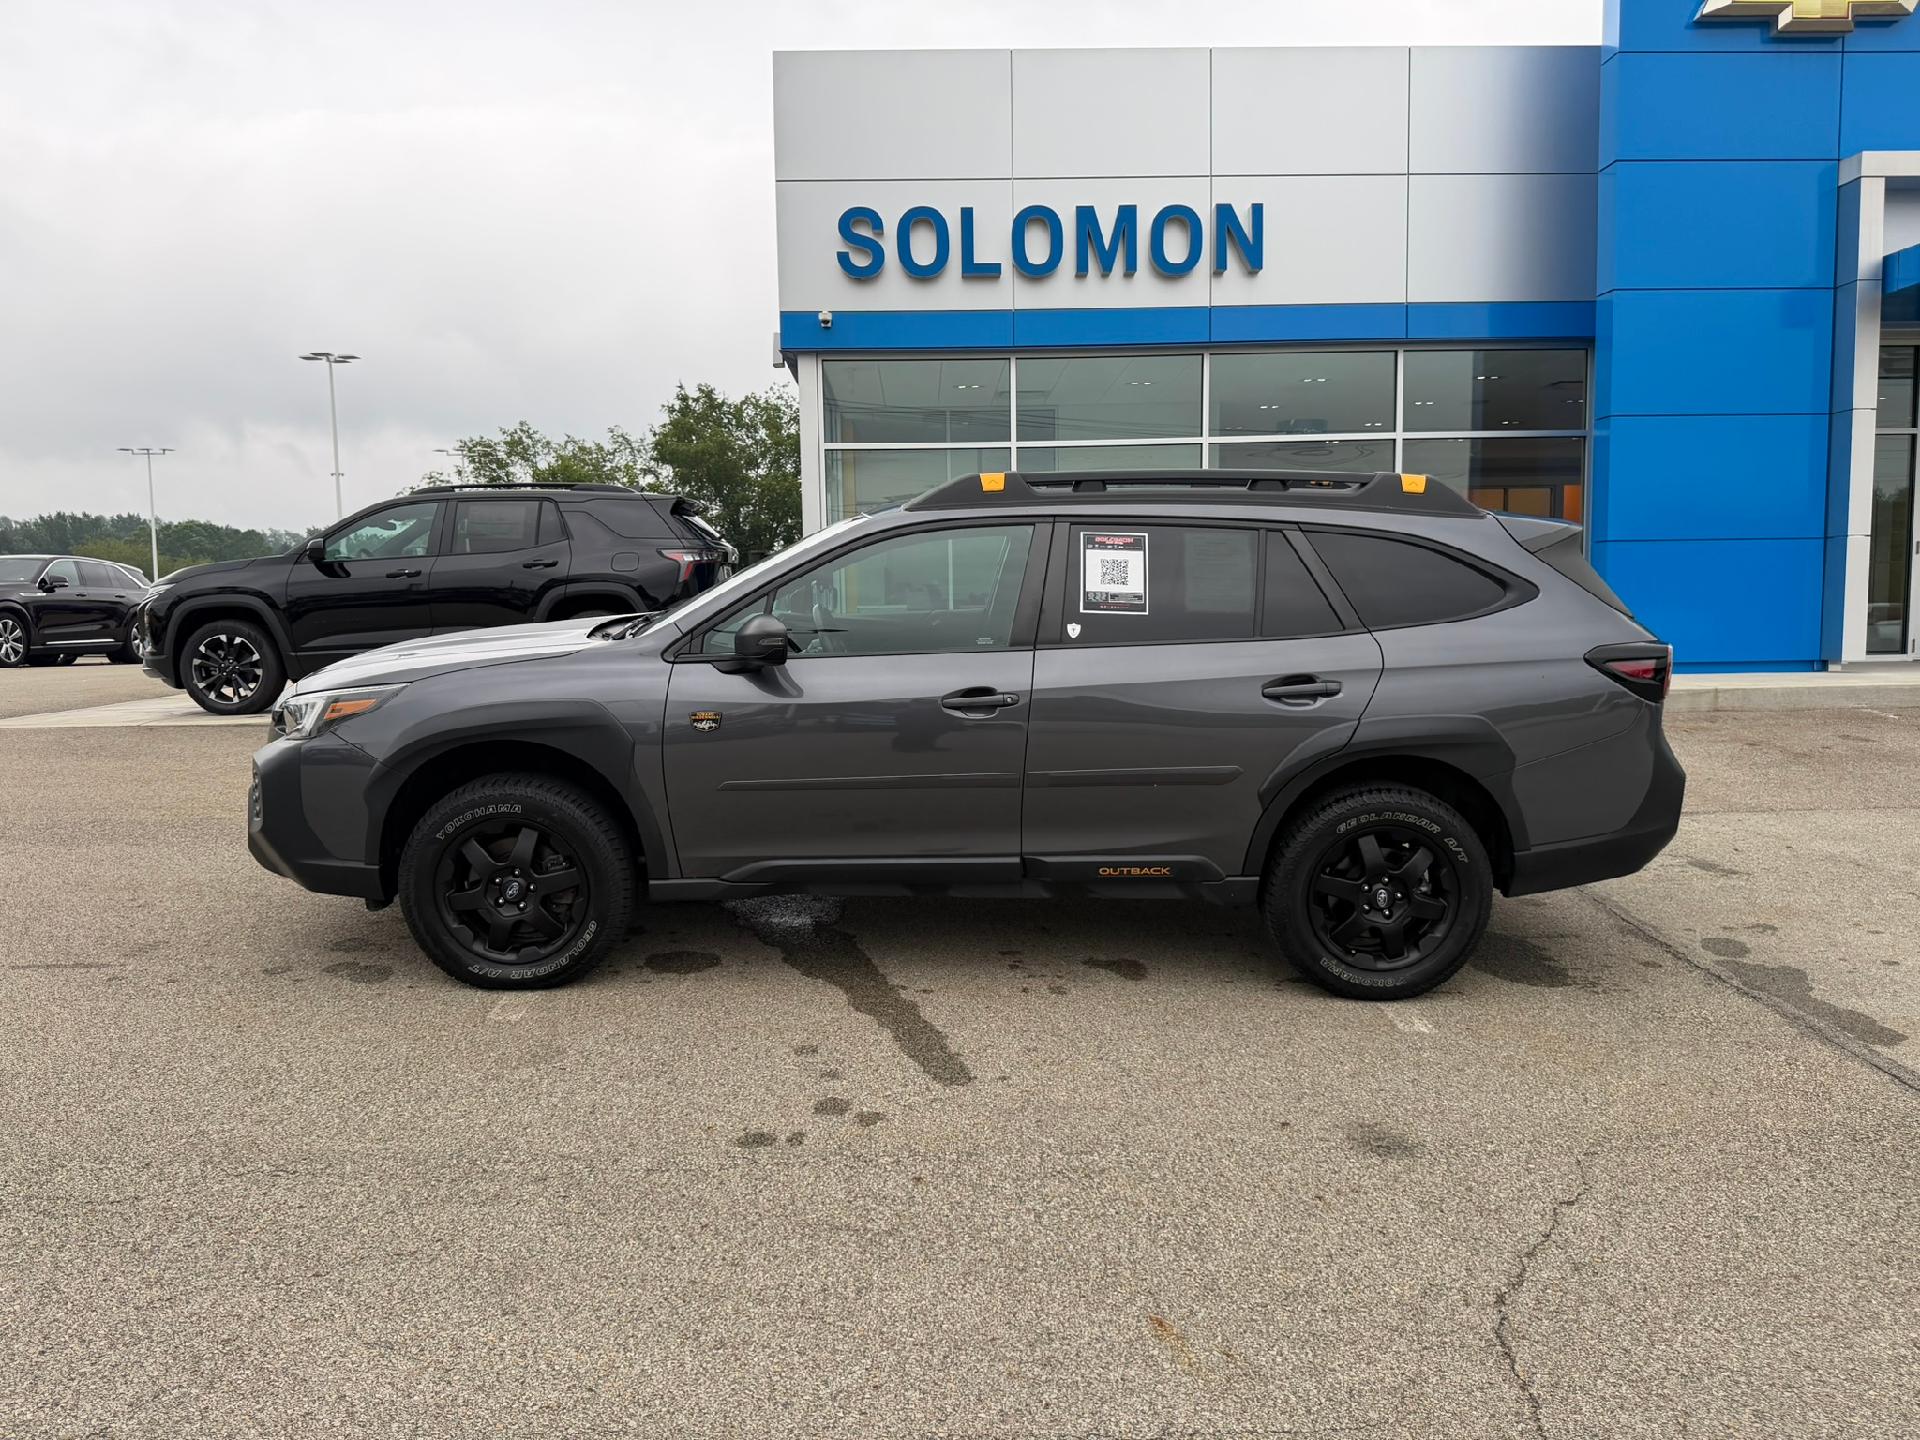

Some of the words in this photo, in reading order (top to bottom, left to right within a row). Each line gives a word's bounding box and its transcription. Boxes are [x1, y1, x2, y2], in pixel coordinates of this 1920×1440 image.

[836, 203, 1264, 280] SOLOMON
[436, 804, 521, 840] YOKOHAMA
[1336, 811, 1441, 834] GEOLANDAR
[1443, 837, 1469, 863] A/T
[1098, 866, 1172, 875] OUTBACK
[510, 920, 597, 979] GEOLANDAR
